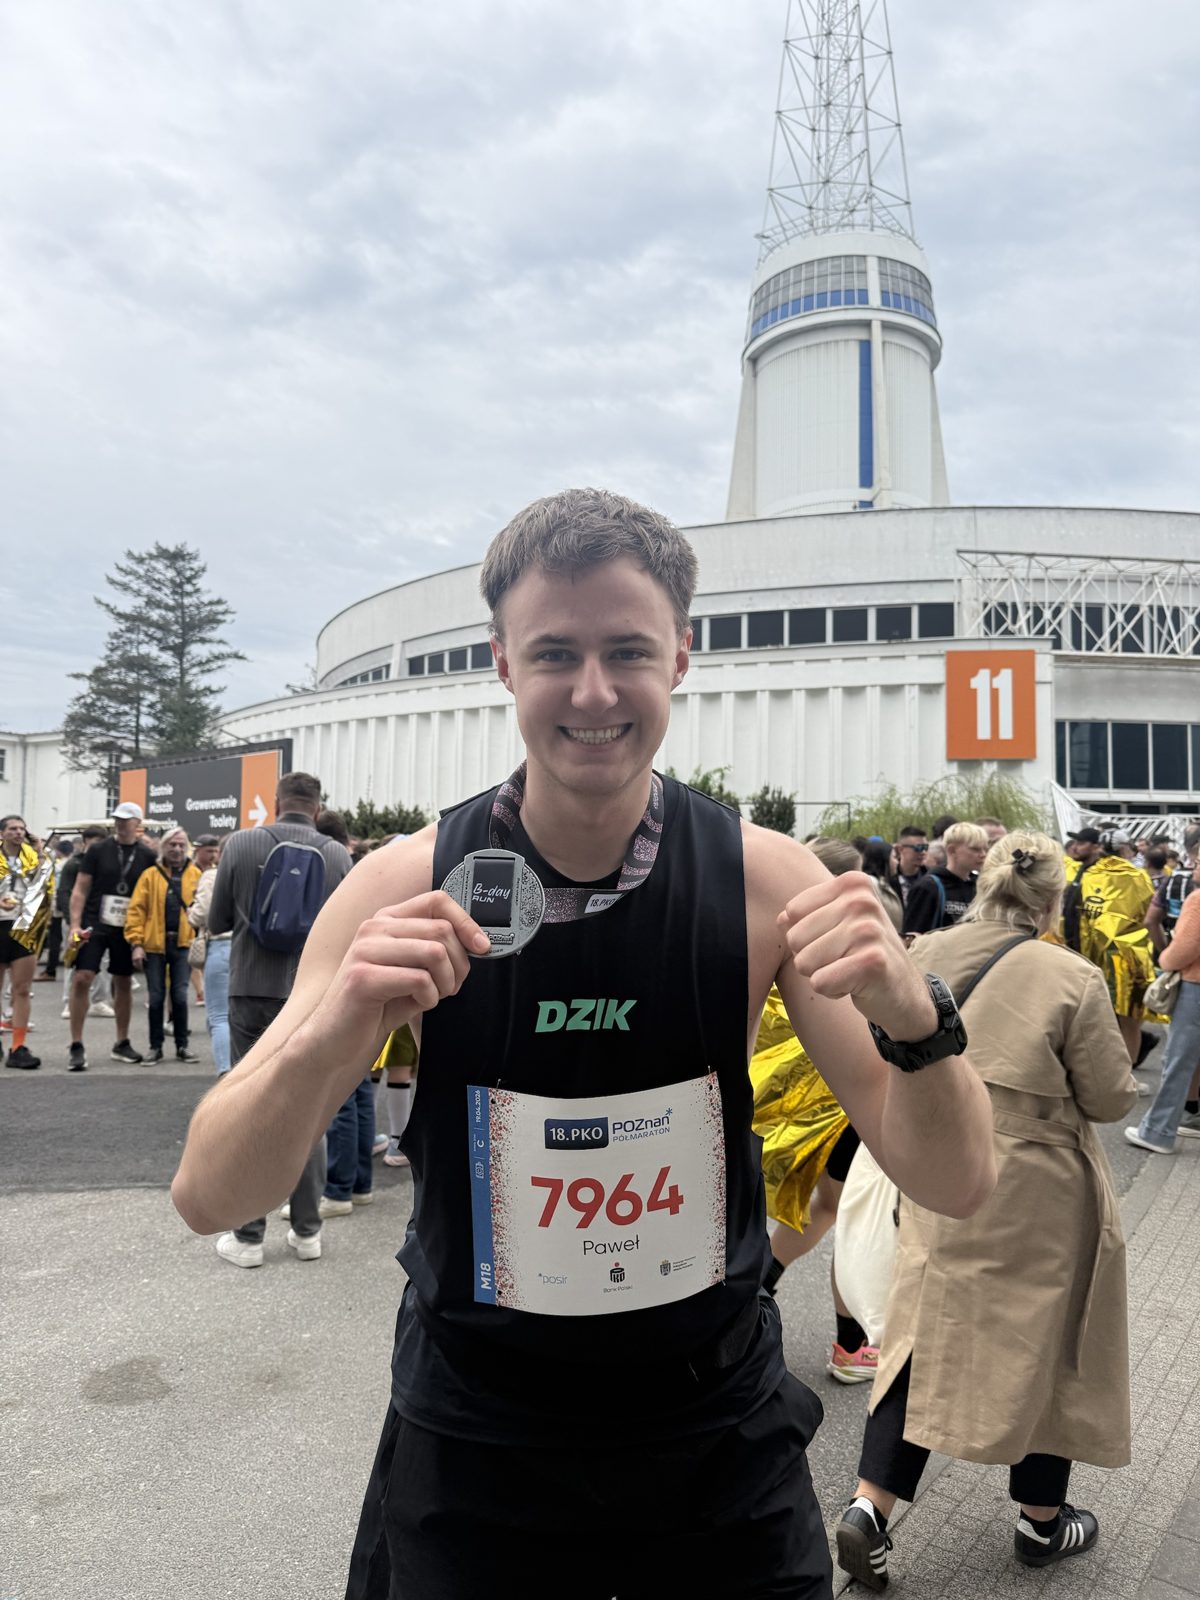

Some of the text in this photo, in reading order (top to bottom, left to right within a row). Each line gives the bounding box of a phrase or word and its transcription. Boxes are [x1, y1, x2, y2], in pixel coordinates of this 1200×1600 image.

[970, 668, 1013, 740] 11
[209, 814, 237, 829] Toalety
[471, 895, 495, 903] RUN
[473, 882, 511, 899] B-day
[535, 999, 637, 1032] DZIK
[549, 1127, 603, 1141] 18.PKO
[612, 1127, 671, 1142] PÓŁMARATON
[477, 1139, 485, 1148] C
[530, 1165, 685, 1229] 7964
[583, 1235, 640, 1256] Paweł
[480, 1262, 492, 1290] M18
